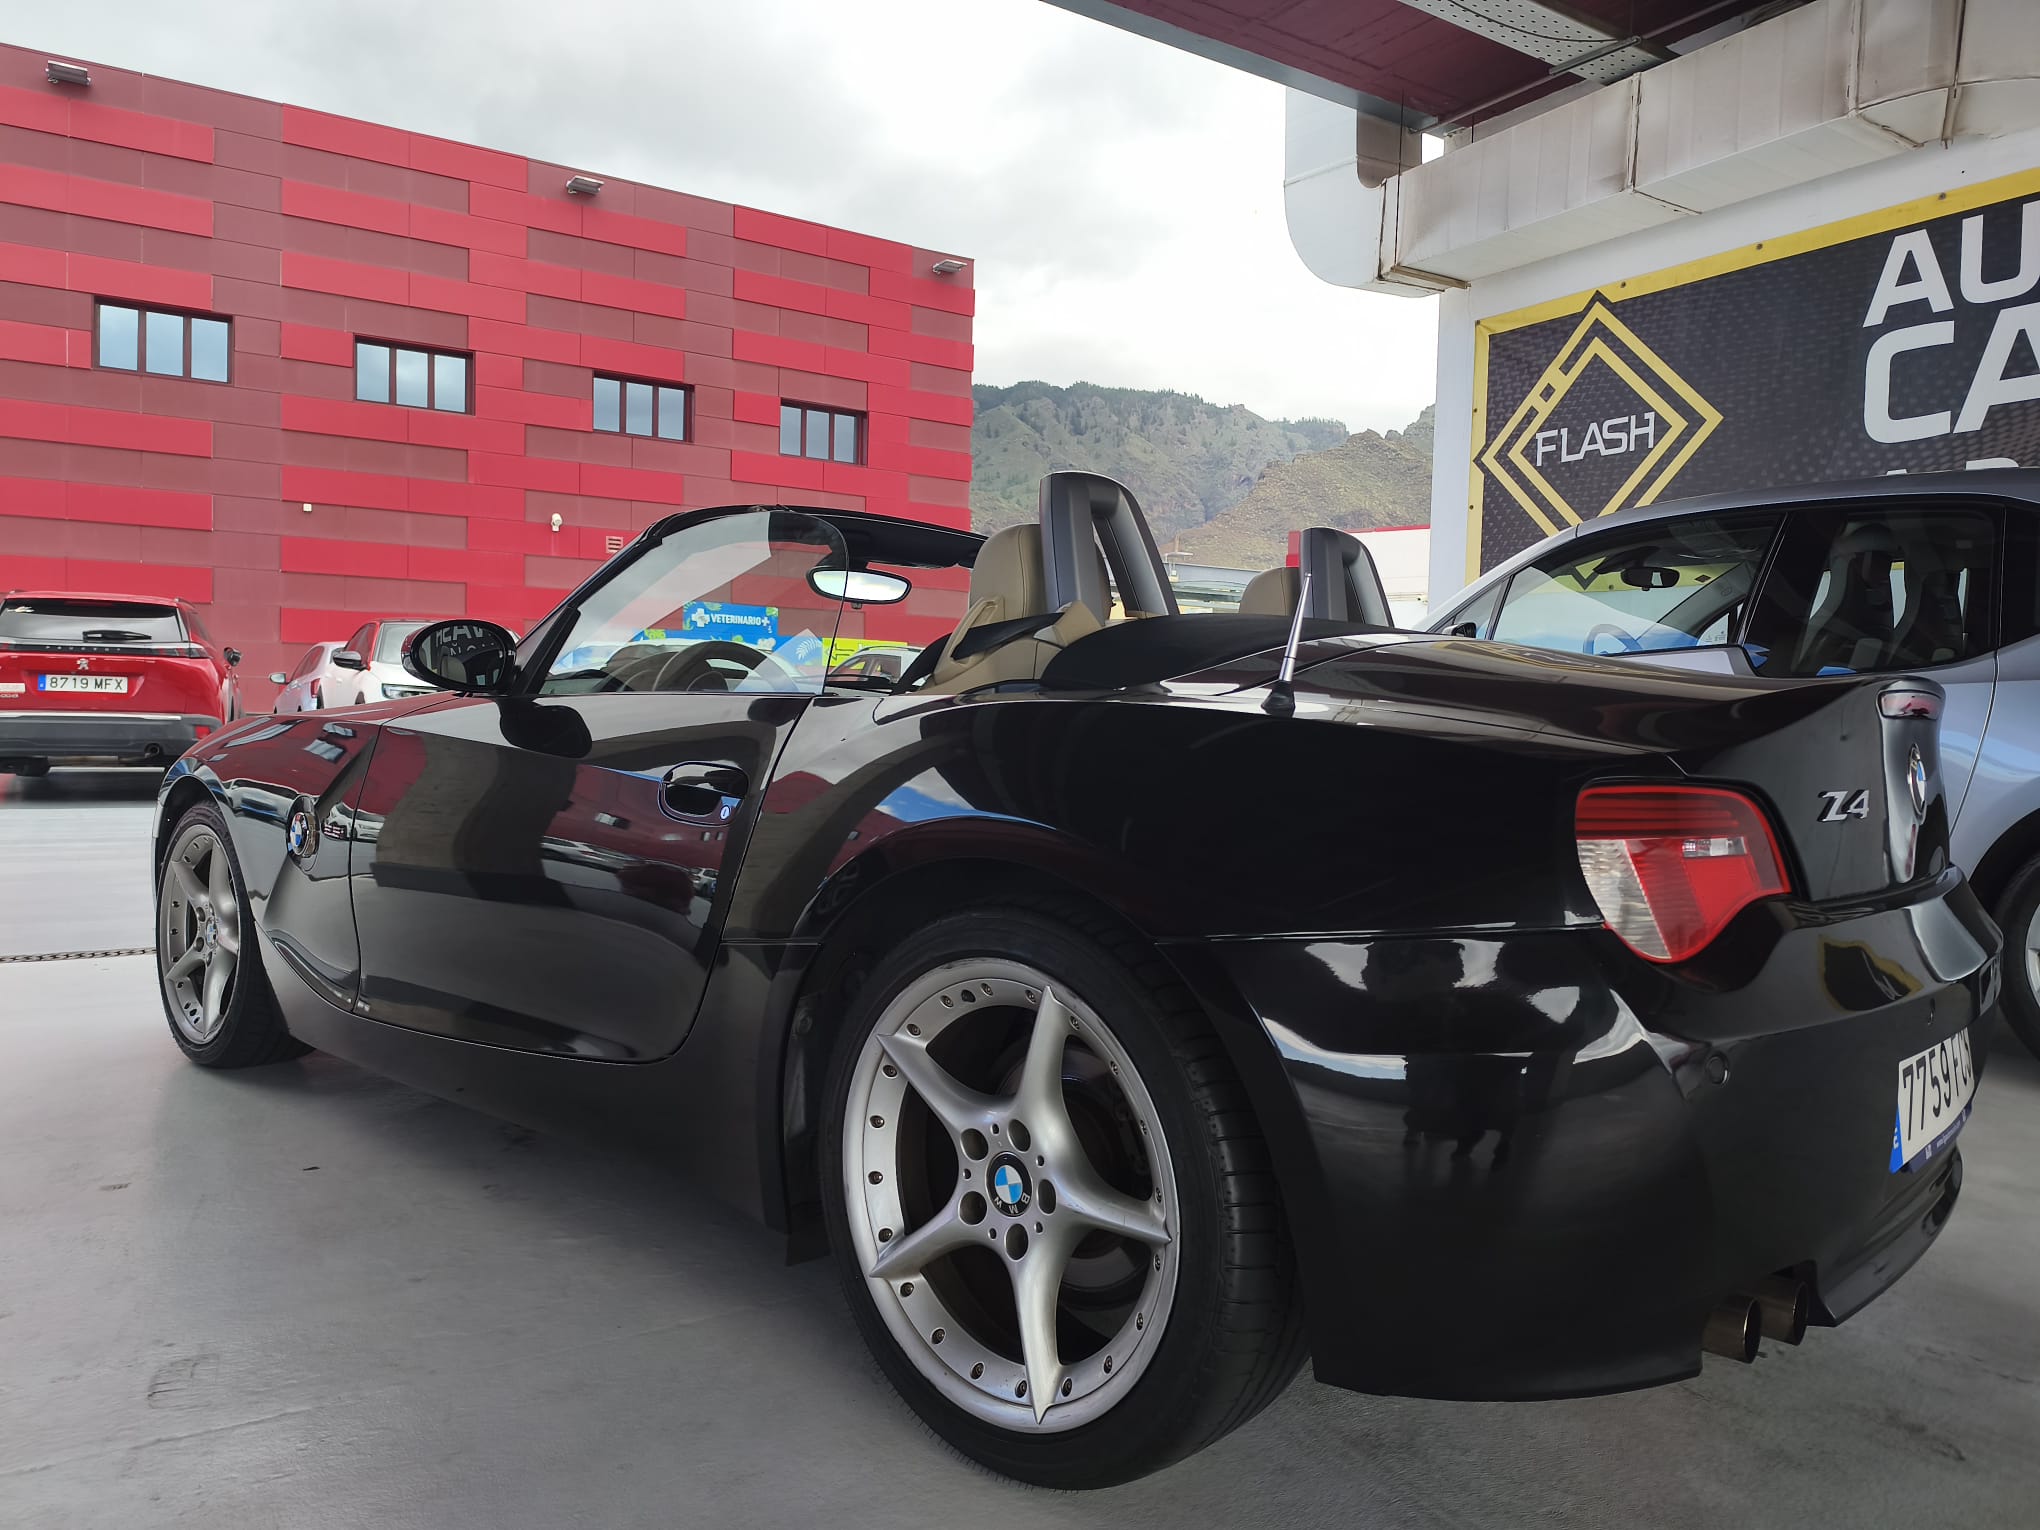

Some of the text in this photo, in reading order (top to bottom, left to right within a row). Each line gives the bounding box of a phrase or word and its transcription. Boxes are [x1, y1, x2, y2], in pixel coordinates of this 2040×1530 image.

[1863, 200, 2040, 328] AU
[1864, 302, 2040, 444] CA
[1536, 412, 1655, 466] FLASH
[710, 613, 762, 627] VETERINARIO
[50, 677, 89, 689] 8719
[94, 678, 123, 690] MFX
[1817, 789, 1870, 823] Z4
[1902, 1042, 1951, 1141] 7759
[994, 1192, 1031, 1214] BMW
